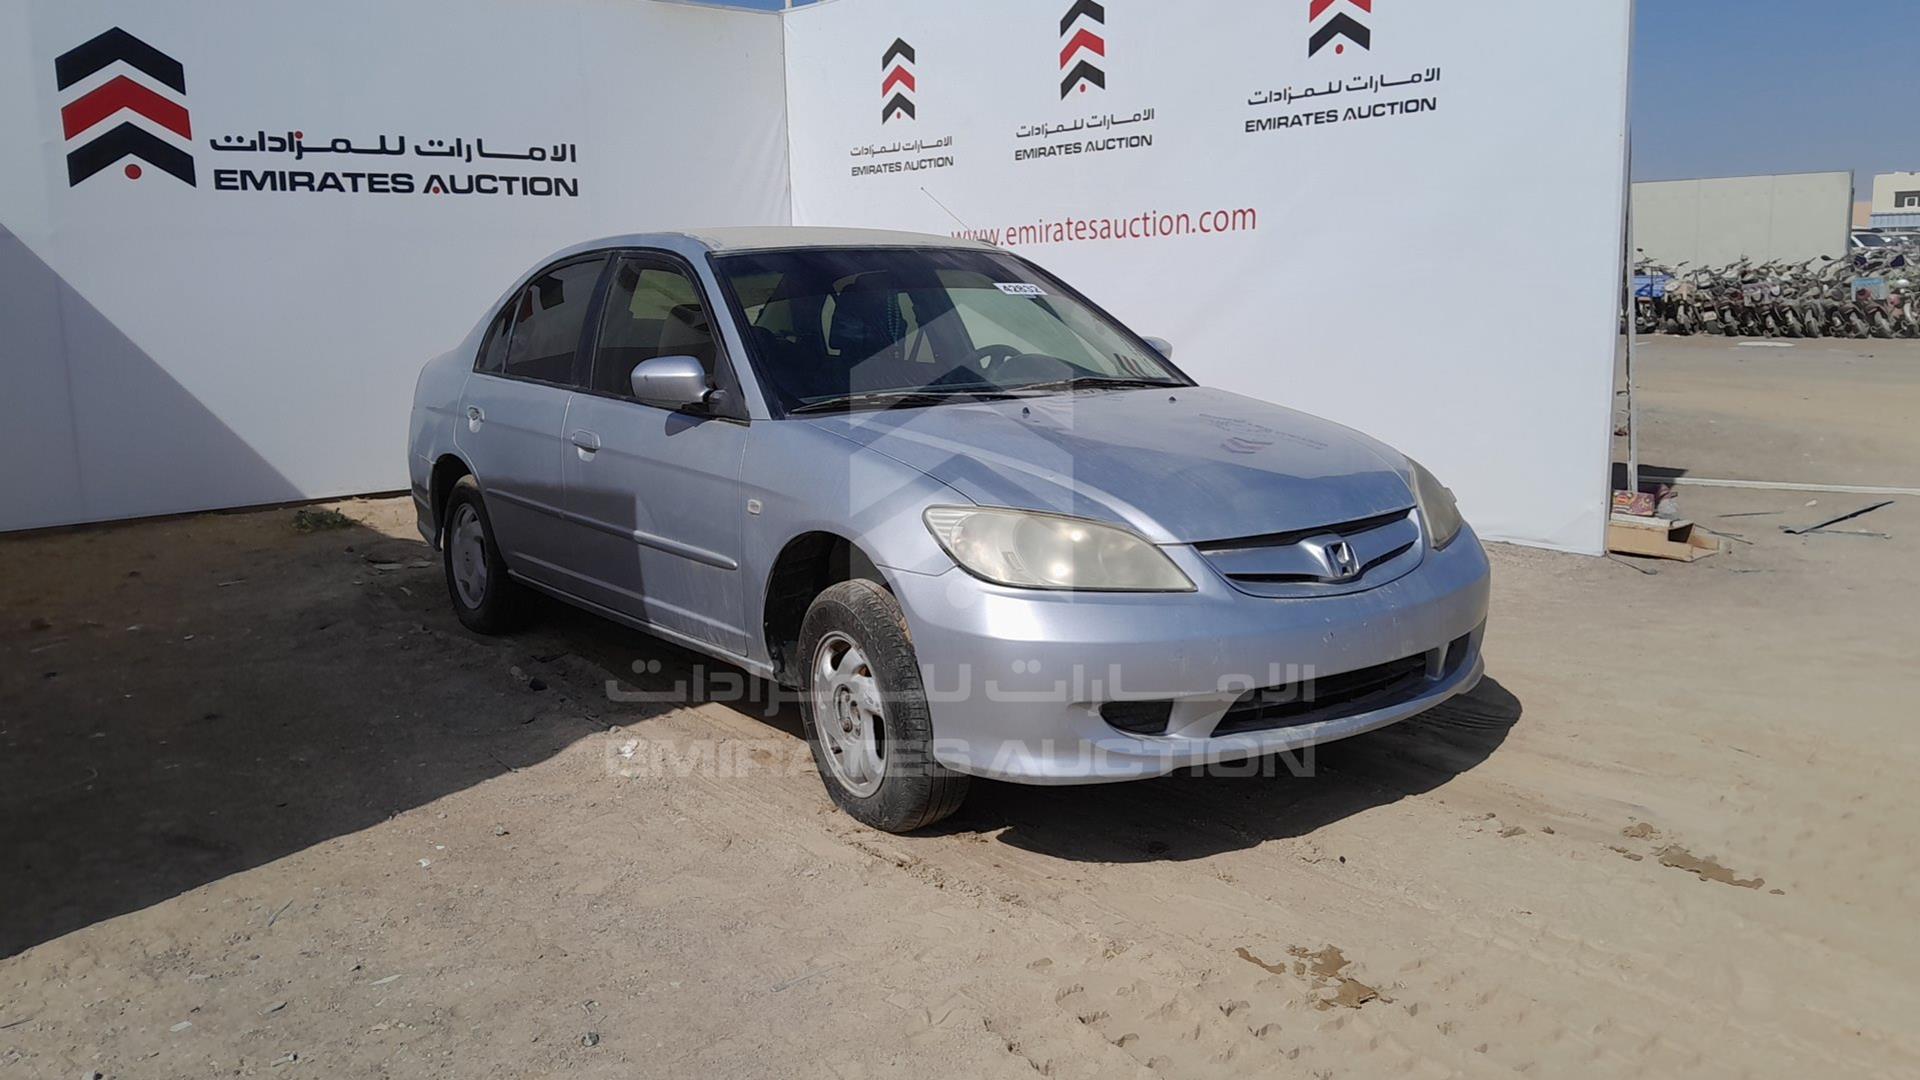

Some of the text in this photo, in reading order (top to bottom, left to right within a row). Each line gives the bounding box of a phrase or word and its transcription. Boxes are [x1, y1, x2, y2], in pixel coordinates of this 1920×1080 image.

[1244, 97, 1437, 133] EMIRATES AUCTION
[1014, 134, 1153, 161] EMIRATES AUCTION
[851, 156, 954, 177] EMIRATES AUCTION
[213, 168, 579, 197] EMIRATES AUCTION
